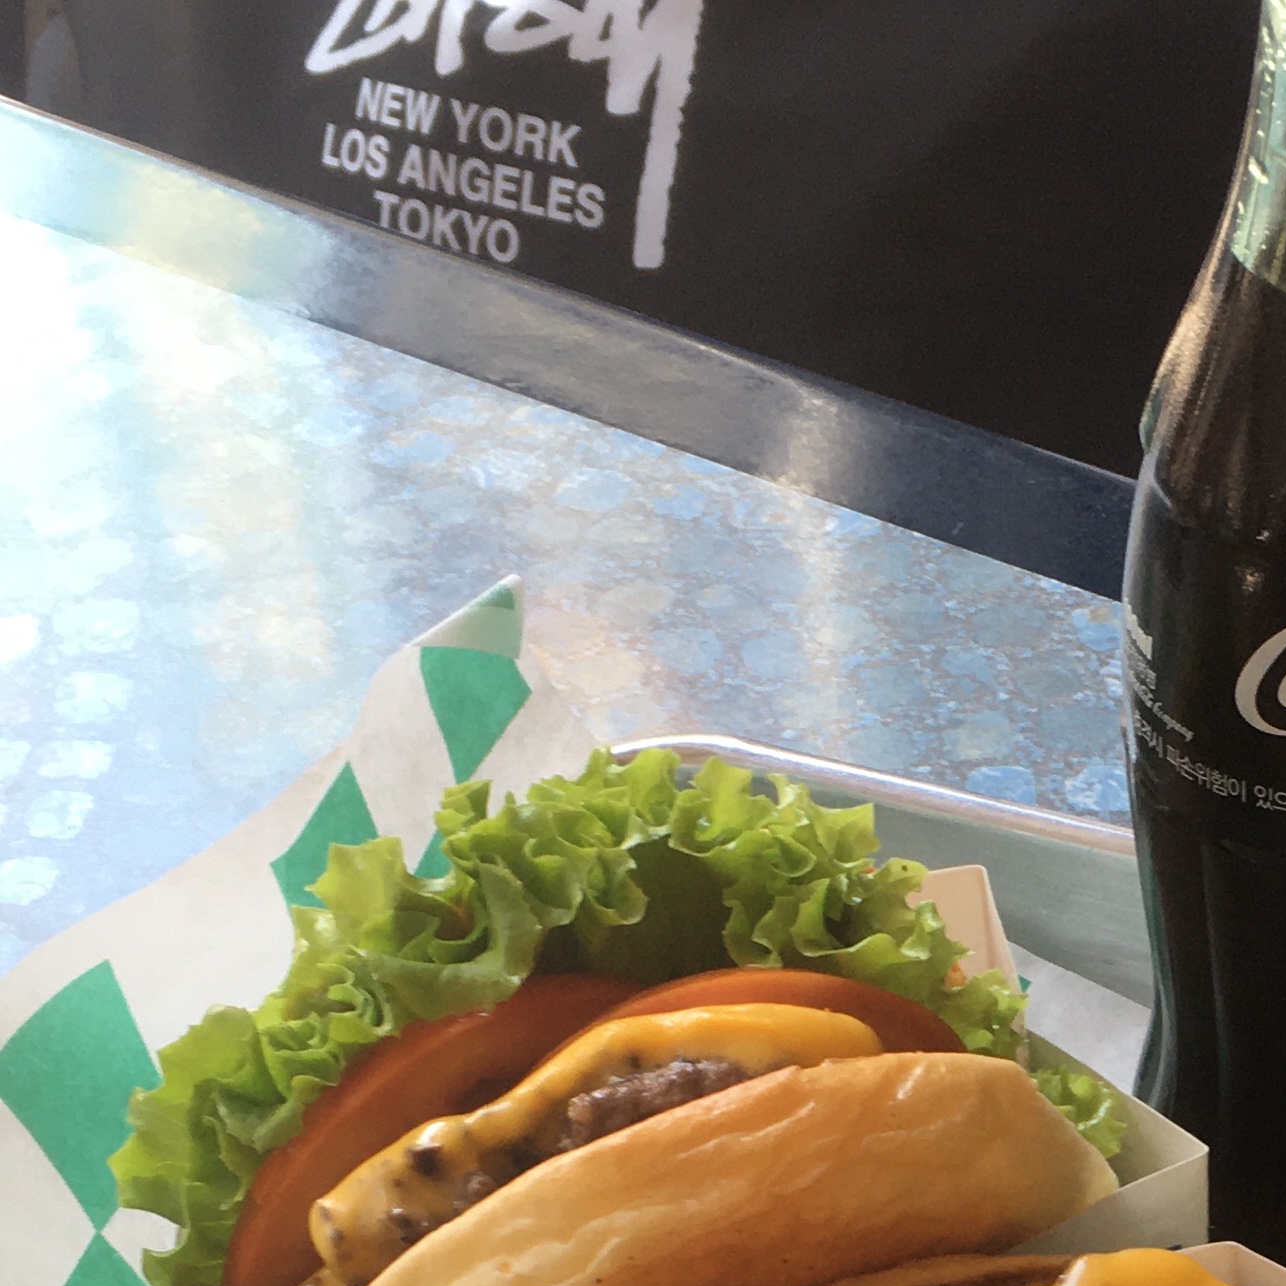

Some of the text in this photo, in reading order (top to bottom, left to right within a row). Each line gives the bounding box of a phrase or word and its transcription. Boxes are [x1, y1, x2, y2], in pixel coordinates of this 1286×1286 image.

[355, 78, 582, 168] NEW YORK
[321, 122, 606, 229] LOS ANGELES
[373, 190, 520, 263] TOKYO
